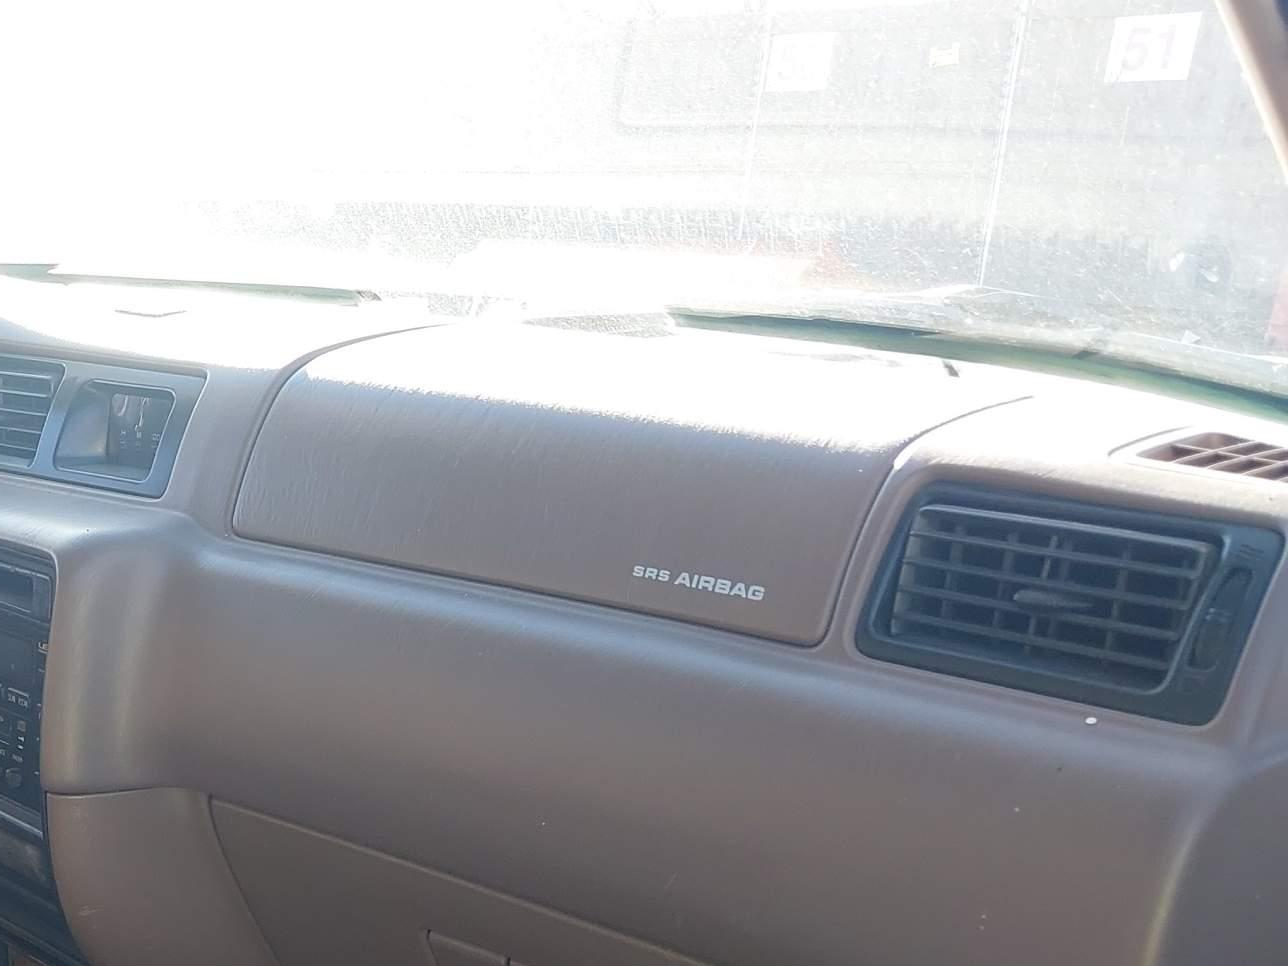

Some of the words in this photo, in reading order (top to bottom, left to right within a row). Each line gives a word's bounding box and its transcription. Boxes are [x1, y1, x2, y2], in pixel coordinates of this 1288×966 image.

[1121, 23, 1177, 71] 51
[632, 565, 671, 582] SRS
[674, 572, 765, 600] AIRBAG
